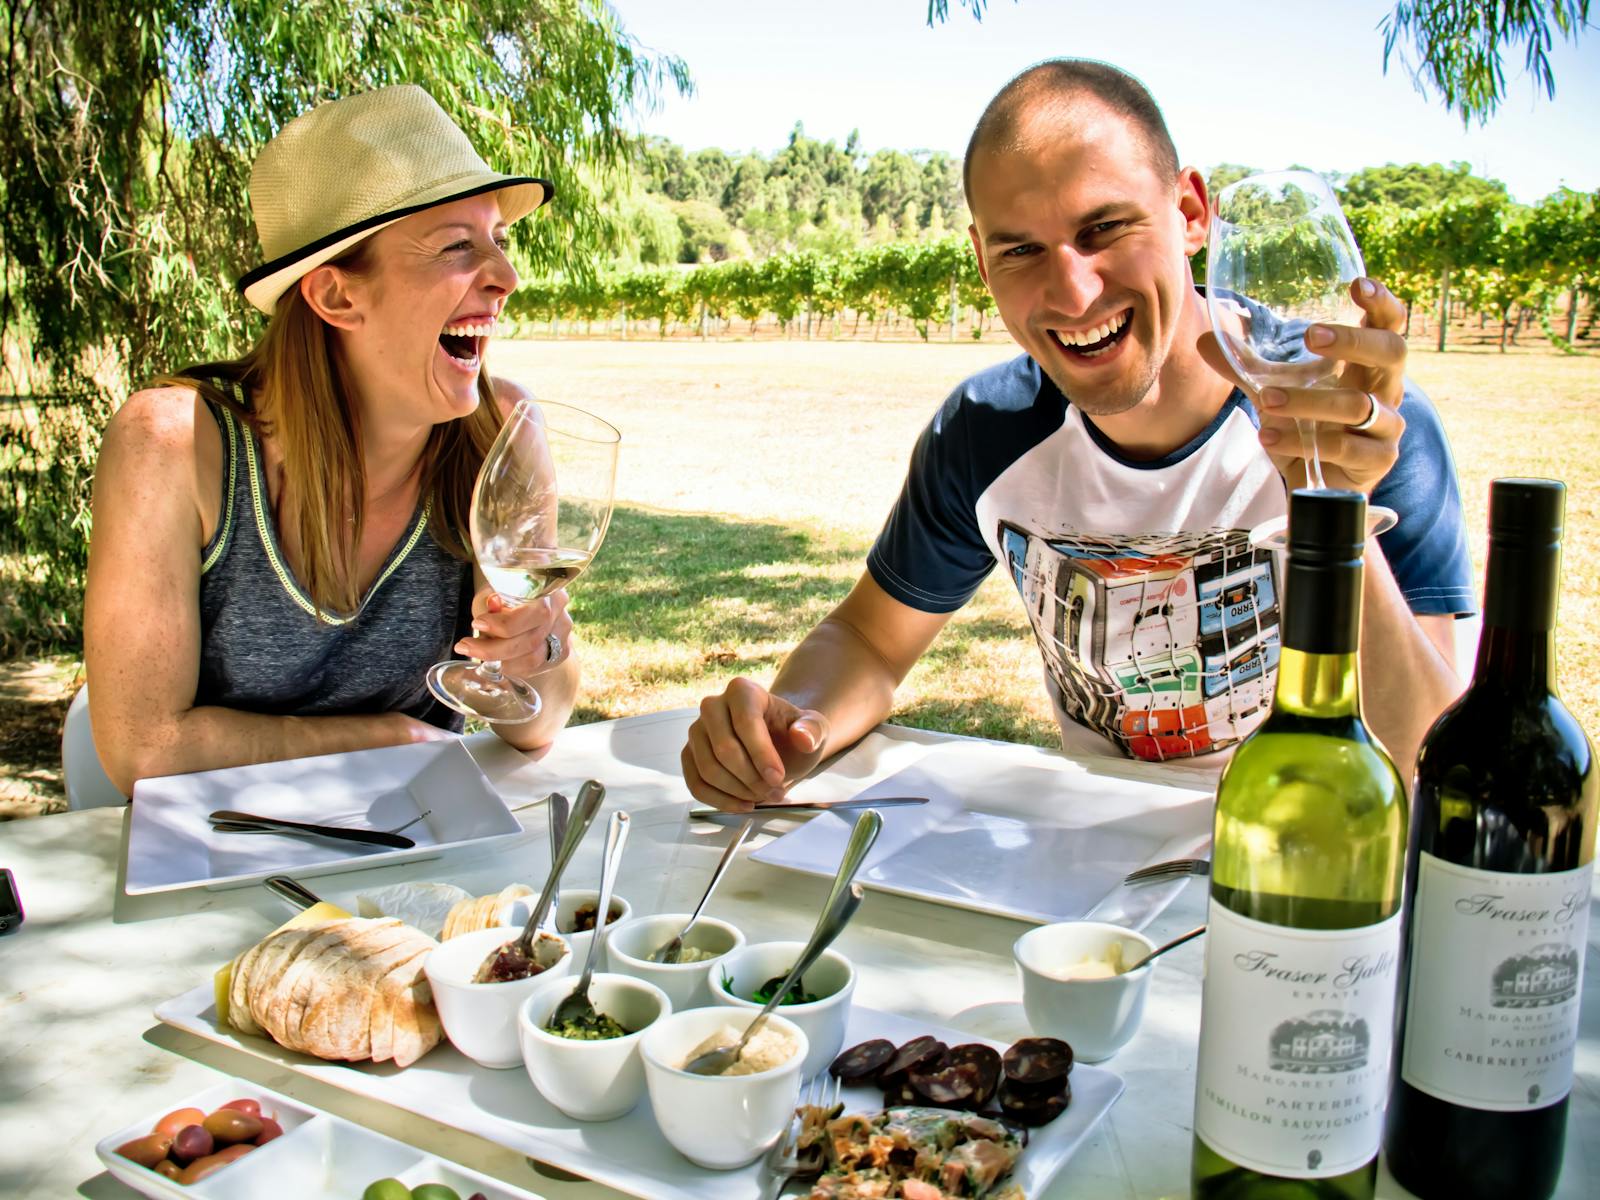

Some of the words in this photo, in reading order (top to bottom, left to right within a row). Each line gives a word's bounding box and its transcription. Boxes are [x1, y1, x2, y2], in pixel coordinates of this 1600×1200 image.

[1230, 599, 1261, 618] FERRO
[1239, 655, 1269, 674] FERRO
[1454, 893, 1549, 921] Fraser
[1516, 923, 1575, 936] ESTATE
[1234, 950, 1328, 985] Fraser
[1292, 989, 1360, 999] ESTATE
[1443, 1047, 1529, 1068] CABERNET
[1280, 1110, 1371, 1129] SAUVIGNON
